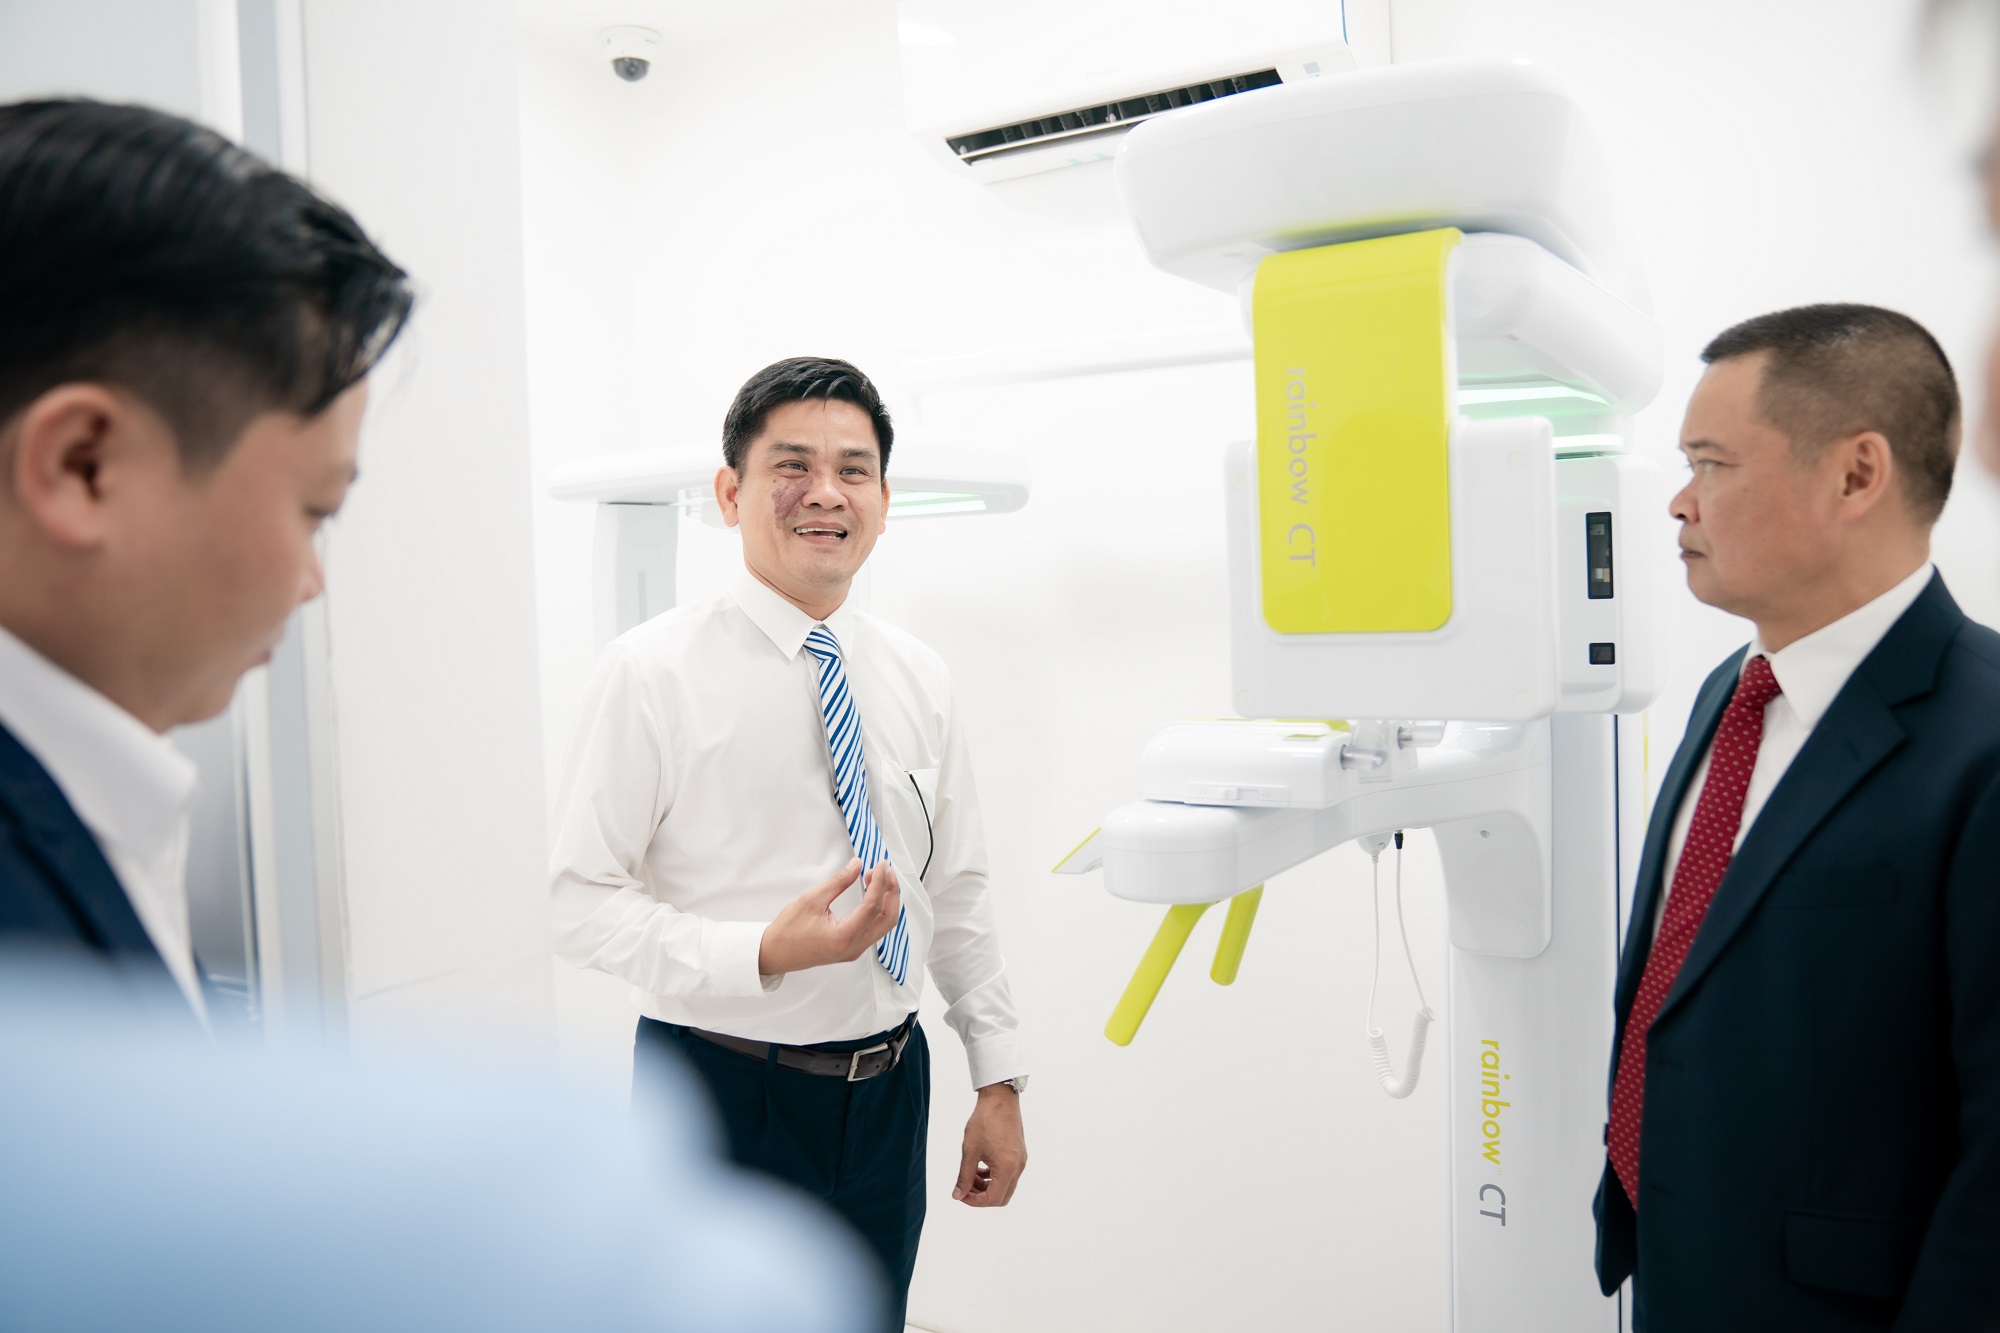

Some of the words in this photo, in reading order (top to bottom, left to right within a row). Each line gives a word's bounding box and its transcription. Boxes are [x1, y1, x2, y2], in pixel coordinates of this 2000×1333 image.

[1286, 367, 1318, 505] rainbow
[1288, 523, 1316, 567] CT
[1481, 1039, 1511, 1165] rainbow
[1479, 1183, 1506, 1226] CT
